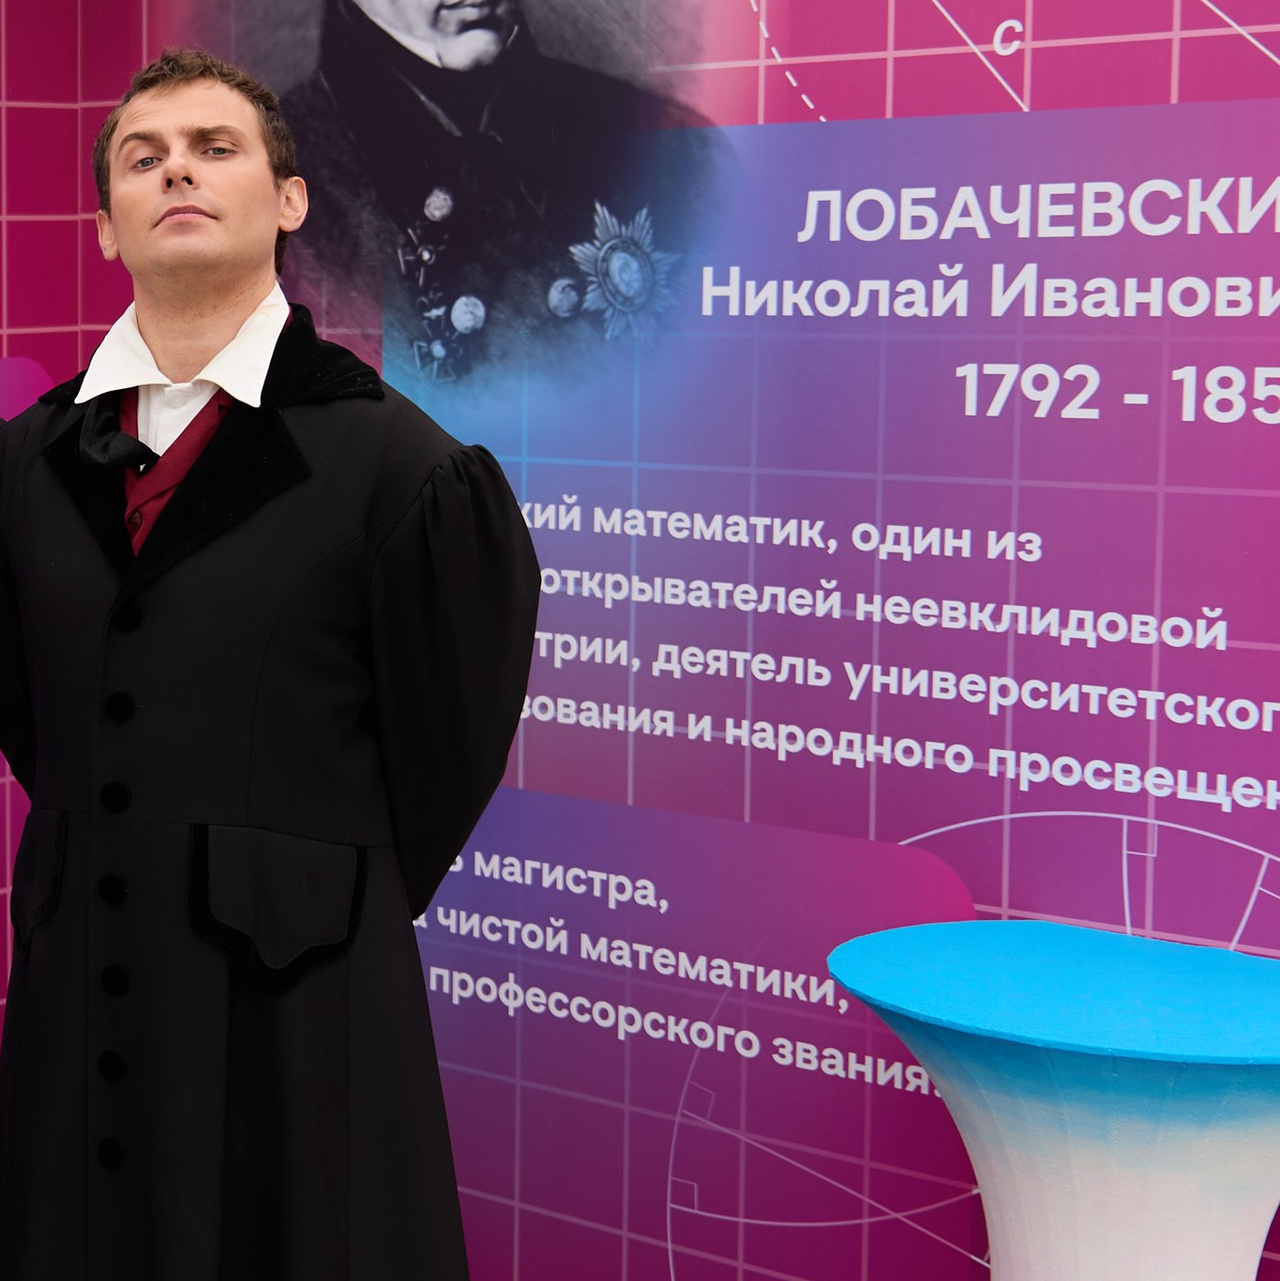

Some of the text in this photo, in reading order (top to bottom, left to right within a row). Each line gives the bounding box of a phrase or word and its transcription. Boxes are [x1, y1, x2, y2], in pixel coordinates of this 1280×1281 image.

[797, 175, 1280, 243] ЛОБАЧЕВСКИ
[701, 262, 1280, 318] Николай Иванови
[955, 363, 1101, 419] 1792
[1172, 365, 1280, 425] 185
[593, 506, 838, 555] математик,
[851, 522, 972, 562] один
[987, 530, 1042, 562] из
[540, 567, 1228, 651] открывателей неевклидовой
[534, 630, 1280, 733] трии, деятель университетског
[687, 713, 712, 742] и
[725, 717, 975, 773] народного
[473, 851, 669, 914] магистра,
[436, 906, 849, 1013] чистой математики,
[429, 965, 761, 1058] профессорского
